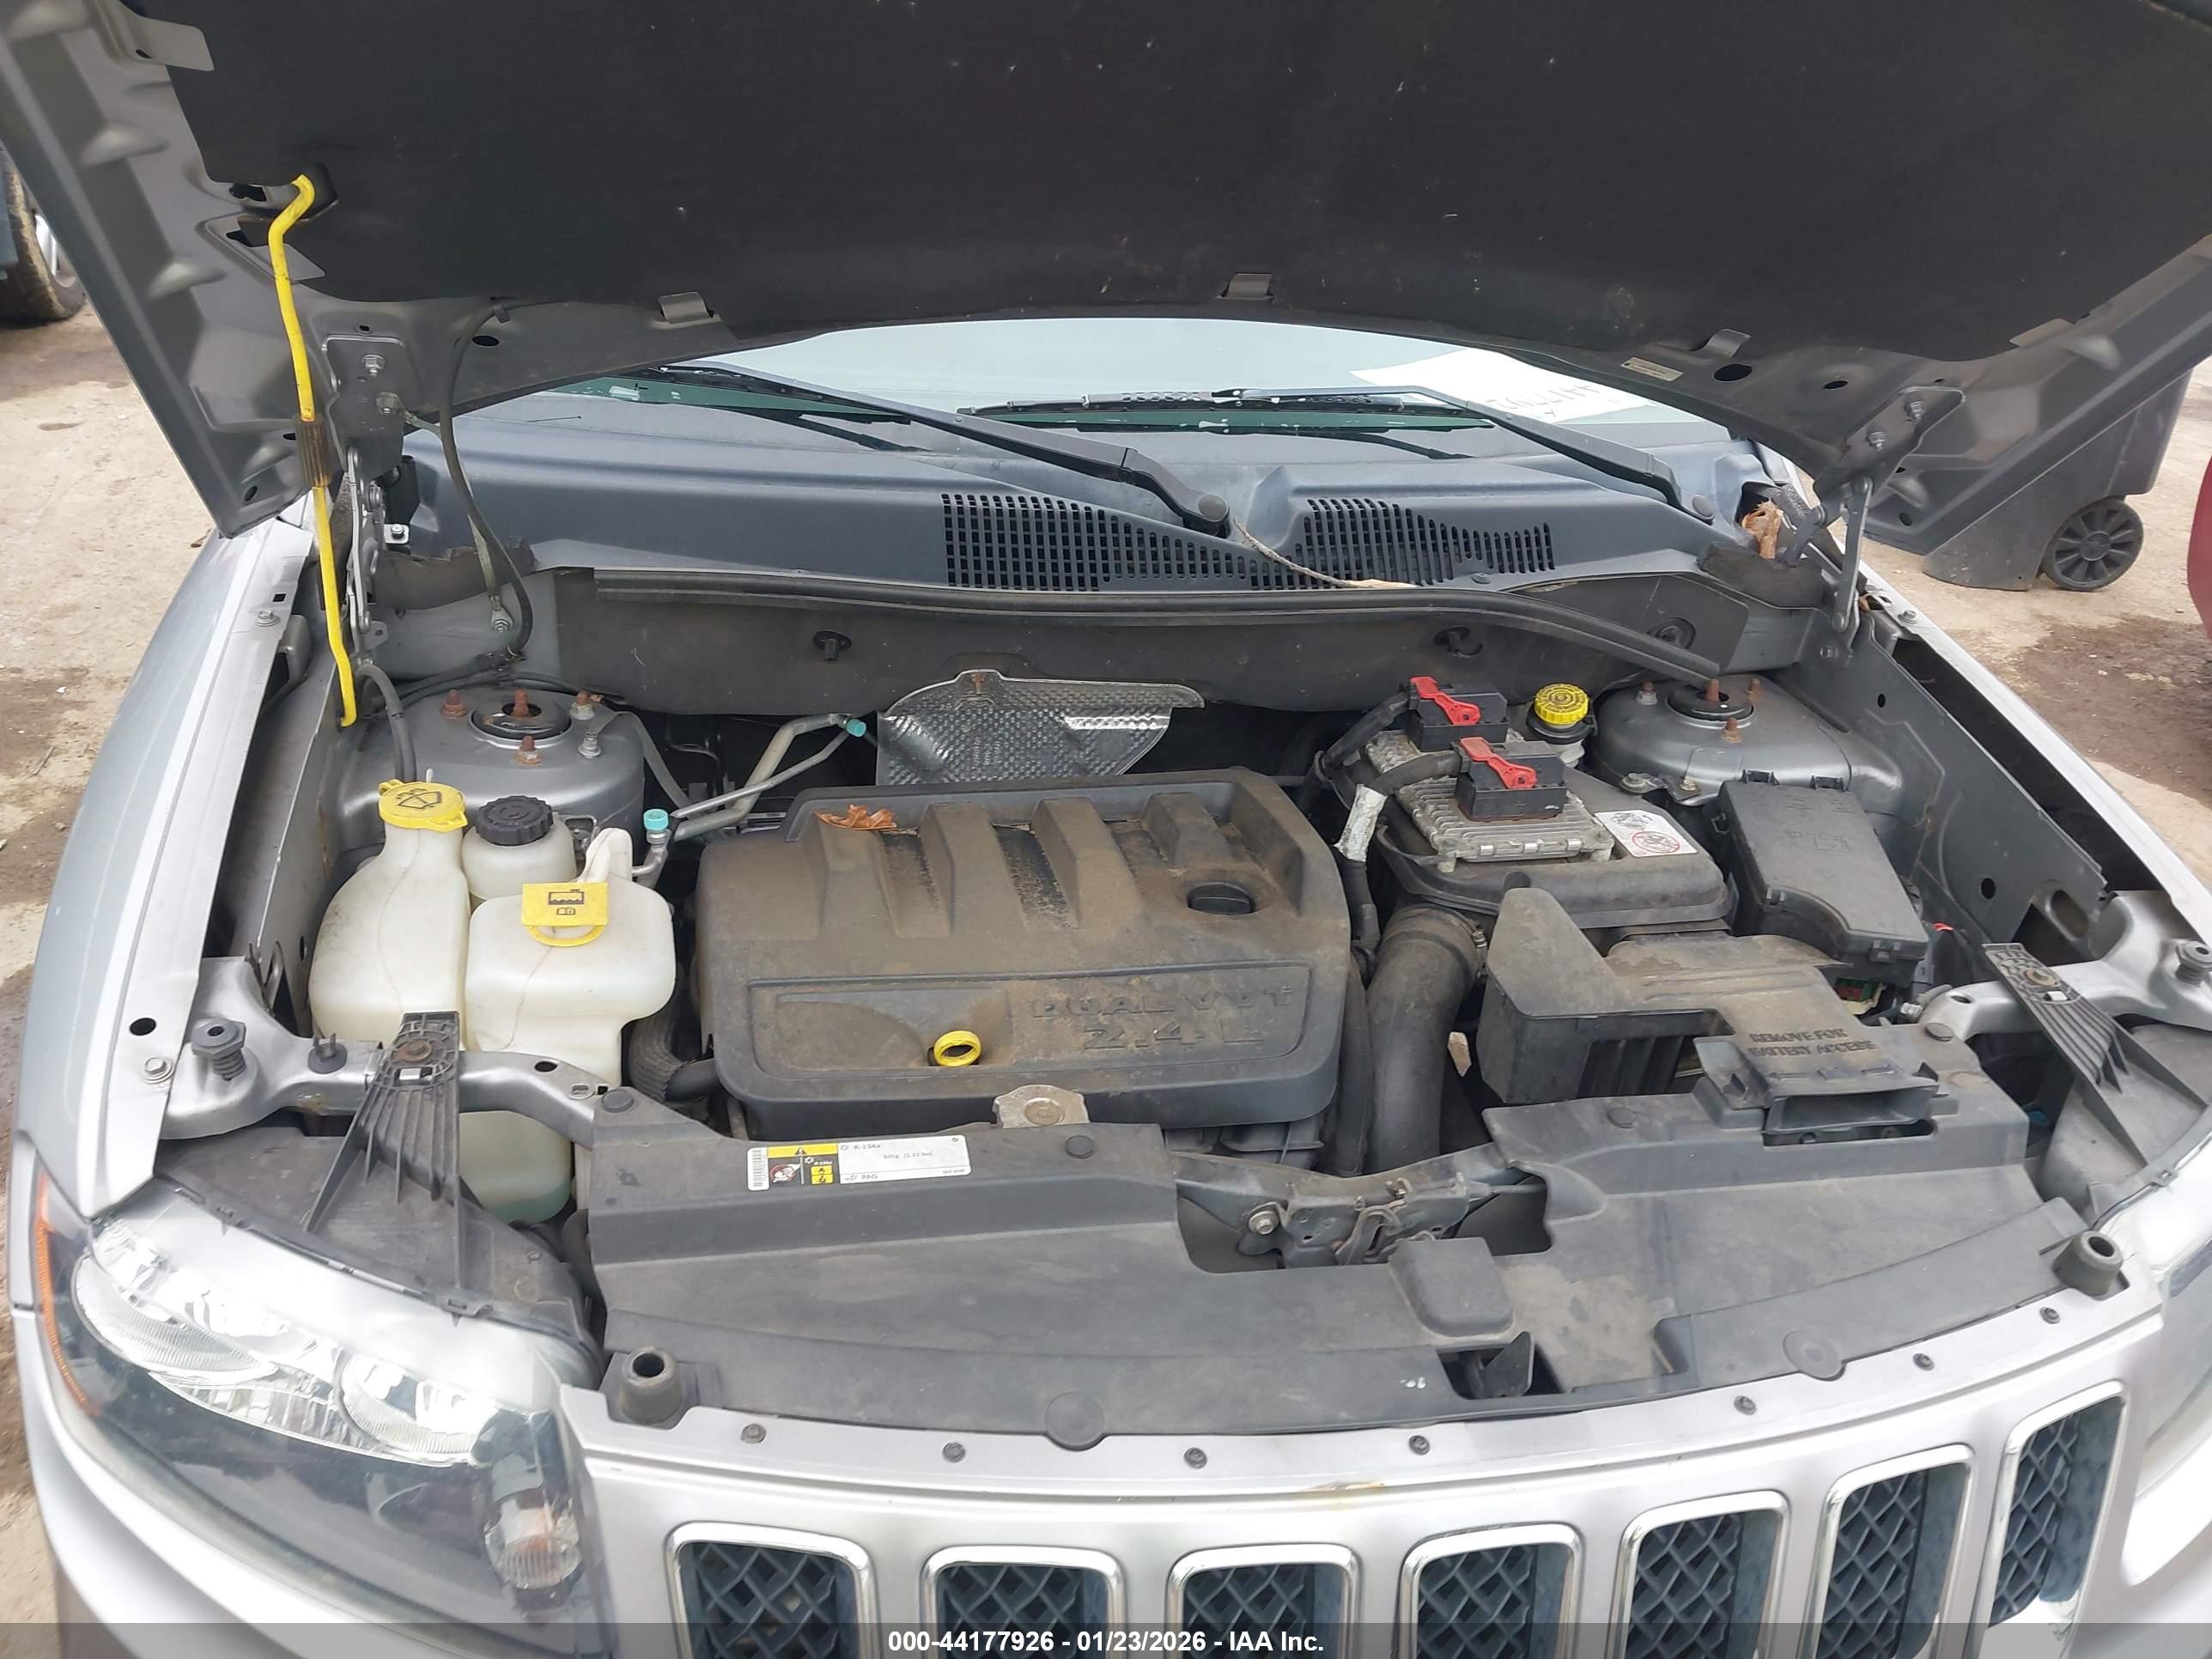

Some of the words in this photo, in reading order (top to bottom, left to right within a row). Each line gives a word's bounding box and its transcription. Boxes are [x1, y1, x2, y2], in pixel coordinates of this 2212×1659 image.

[1031, 994, 1176, 1018] DUAL
[1181, 986, 1294, 1012] VVT
[1749, 1031, 1814, 1042] REMOVE
[1814, 1028, 1849, 1040] FOR
[1747, 1045, 1812, 1057] BATTERY
[1816, 1041, 1876, 1054] ACCESS
